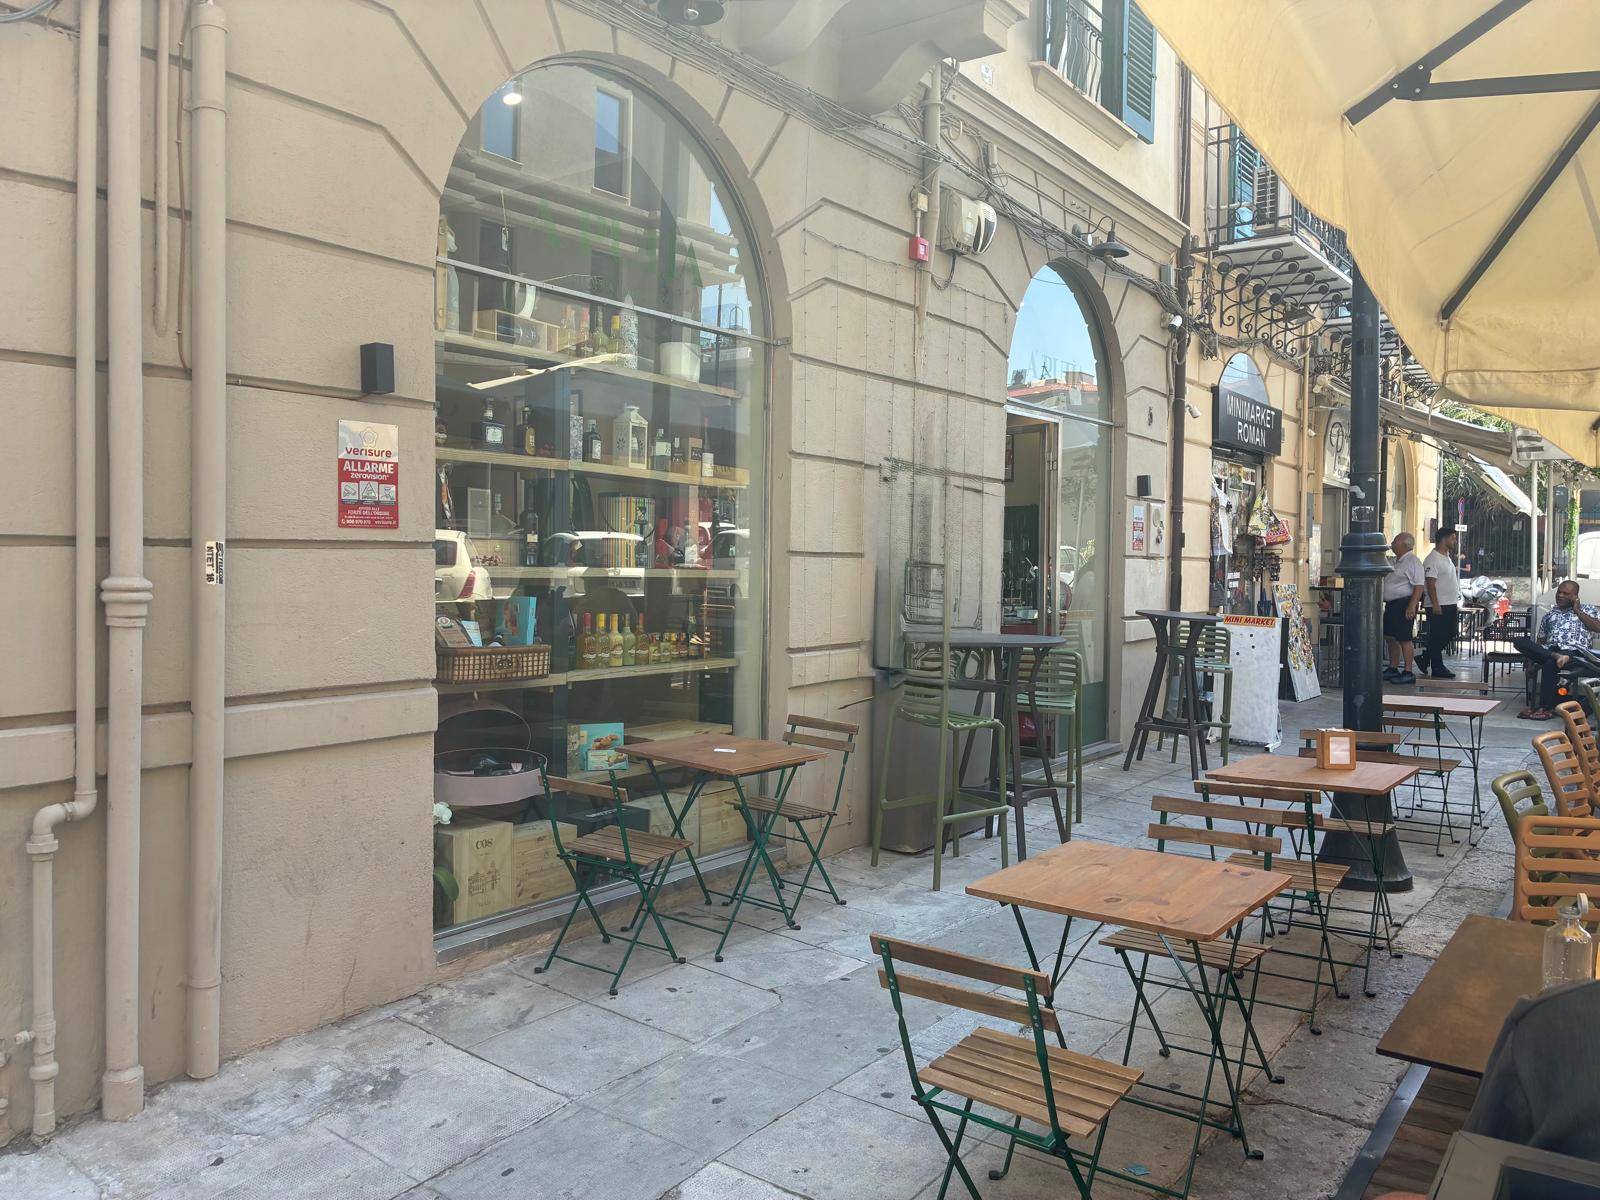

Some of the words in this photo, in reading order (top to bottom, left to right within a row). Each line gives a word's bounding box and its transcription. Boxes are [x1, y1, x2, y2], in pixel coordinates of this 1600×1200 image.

[1227, 394, 1275, 429] MINIMARKET
[1237, 421, 1266, 447] ROMAN
[345, 447, 392, 458] verisure
[343, 461, 394, 474] ALLARME
[1224, 615, 1242, 623] MINI
[1244, 616, 1275, 626] MARKET
